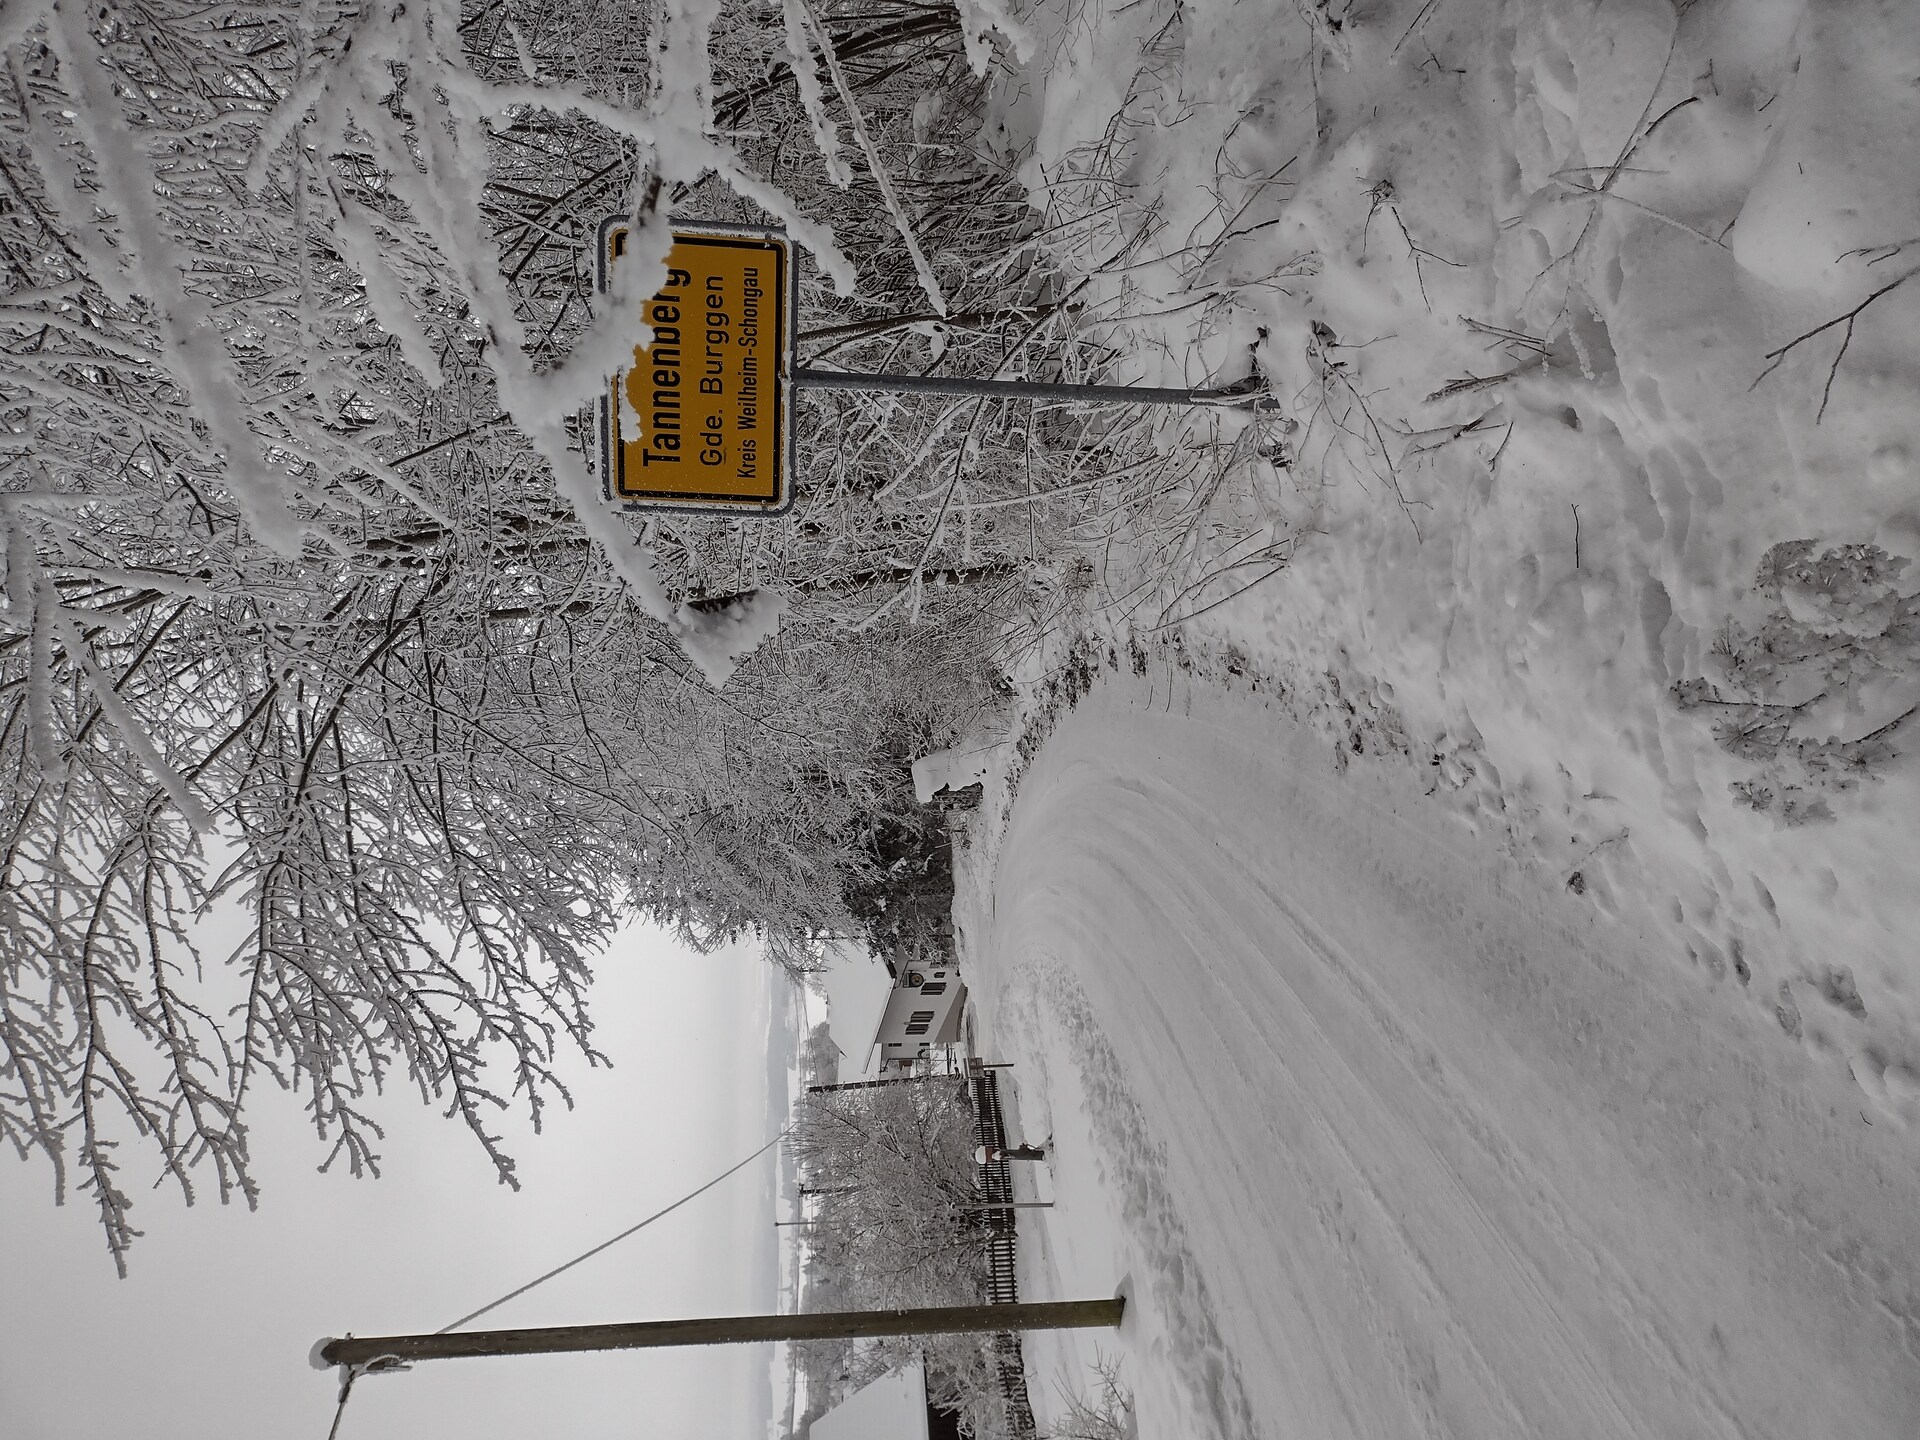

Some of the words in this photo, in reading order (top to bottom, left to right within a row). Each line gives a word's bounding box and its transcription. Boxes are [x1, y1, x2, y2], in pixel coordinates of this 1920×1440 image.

[642, 268, 692, 467] Tannenberg
[700, 275, 730, 395] Burggen
[738, 267, 763, 430] Weilheim-Schongau
[699, 409, 723, 466] Gde.
[737, 439, 757, 479] Kreis
